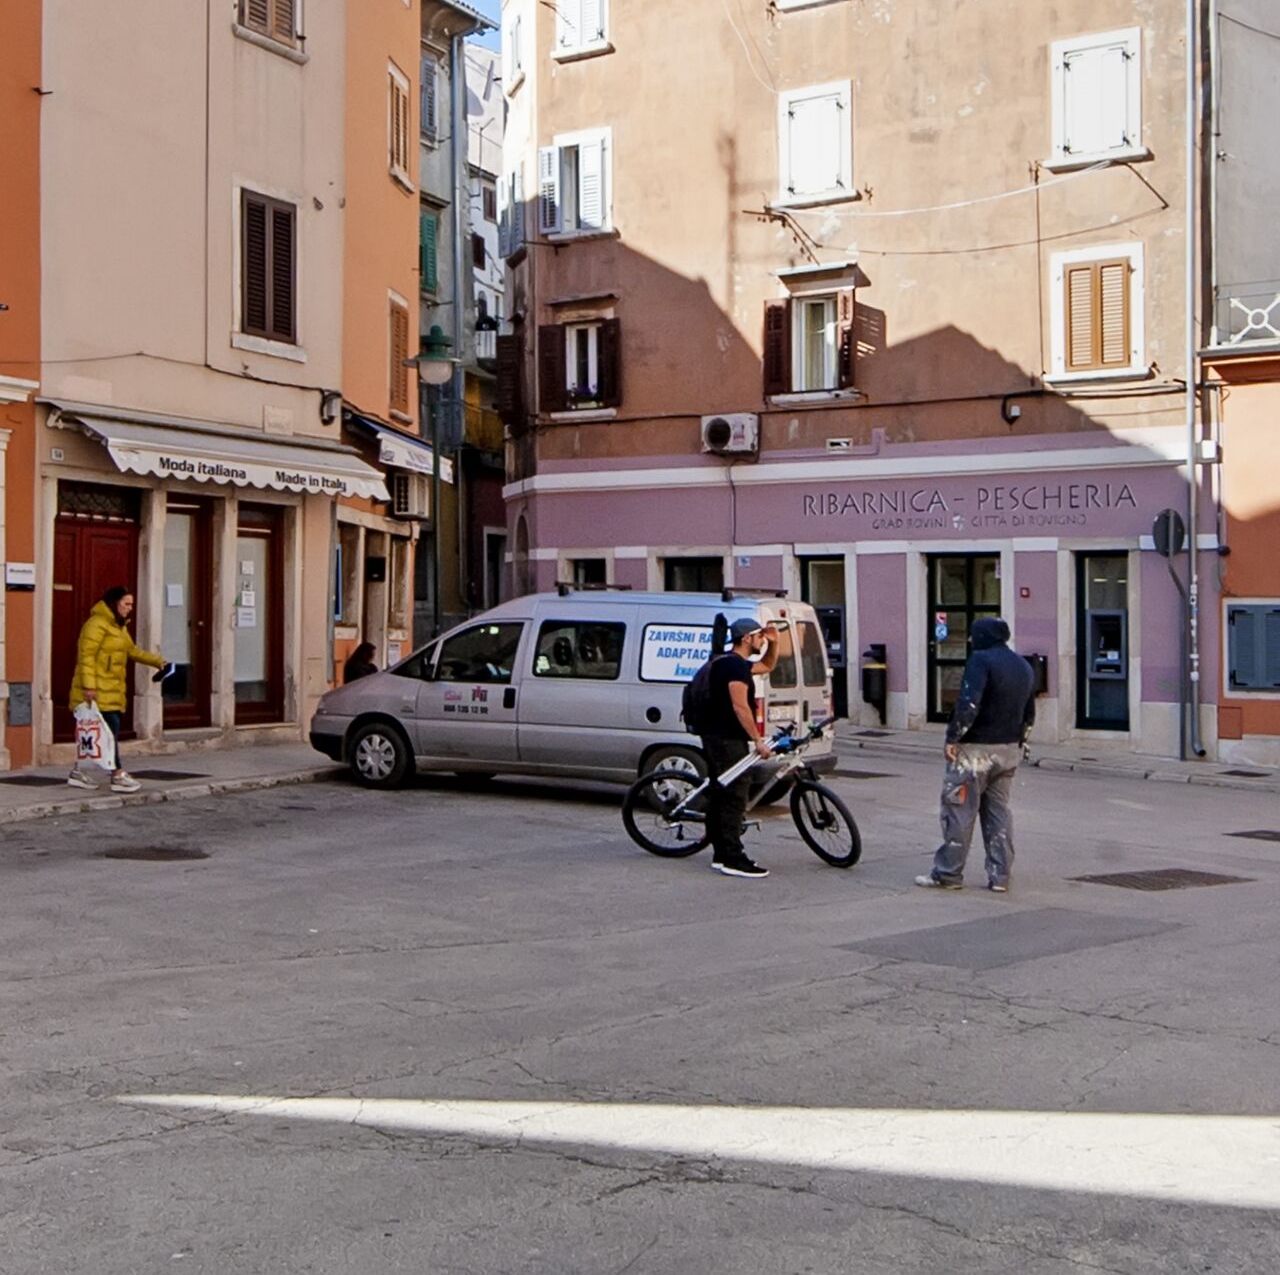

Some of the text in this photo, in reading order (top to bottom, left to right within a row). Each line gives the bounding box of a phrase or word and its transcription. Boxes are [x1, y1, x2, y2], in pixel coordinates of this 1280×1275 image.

[159, 457, 247, 479] Moda italiana
[275, 471, 347, 492] Made in Italy
[803, 490, 949, 515] RIBARNICA
[977, 484, 1137, 510] PESCHERIA
[872, 518, 903, 530] GRAD
[648, 630, 695, 643] ZAVRŠNI
[656, 647, 710, 660] ADAPTAC
[81, 736, 94, 751] M
